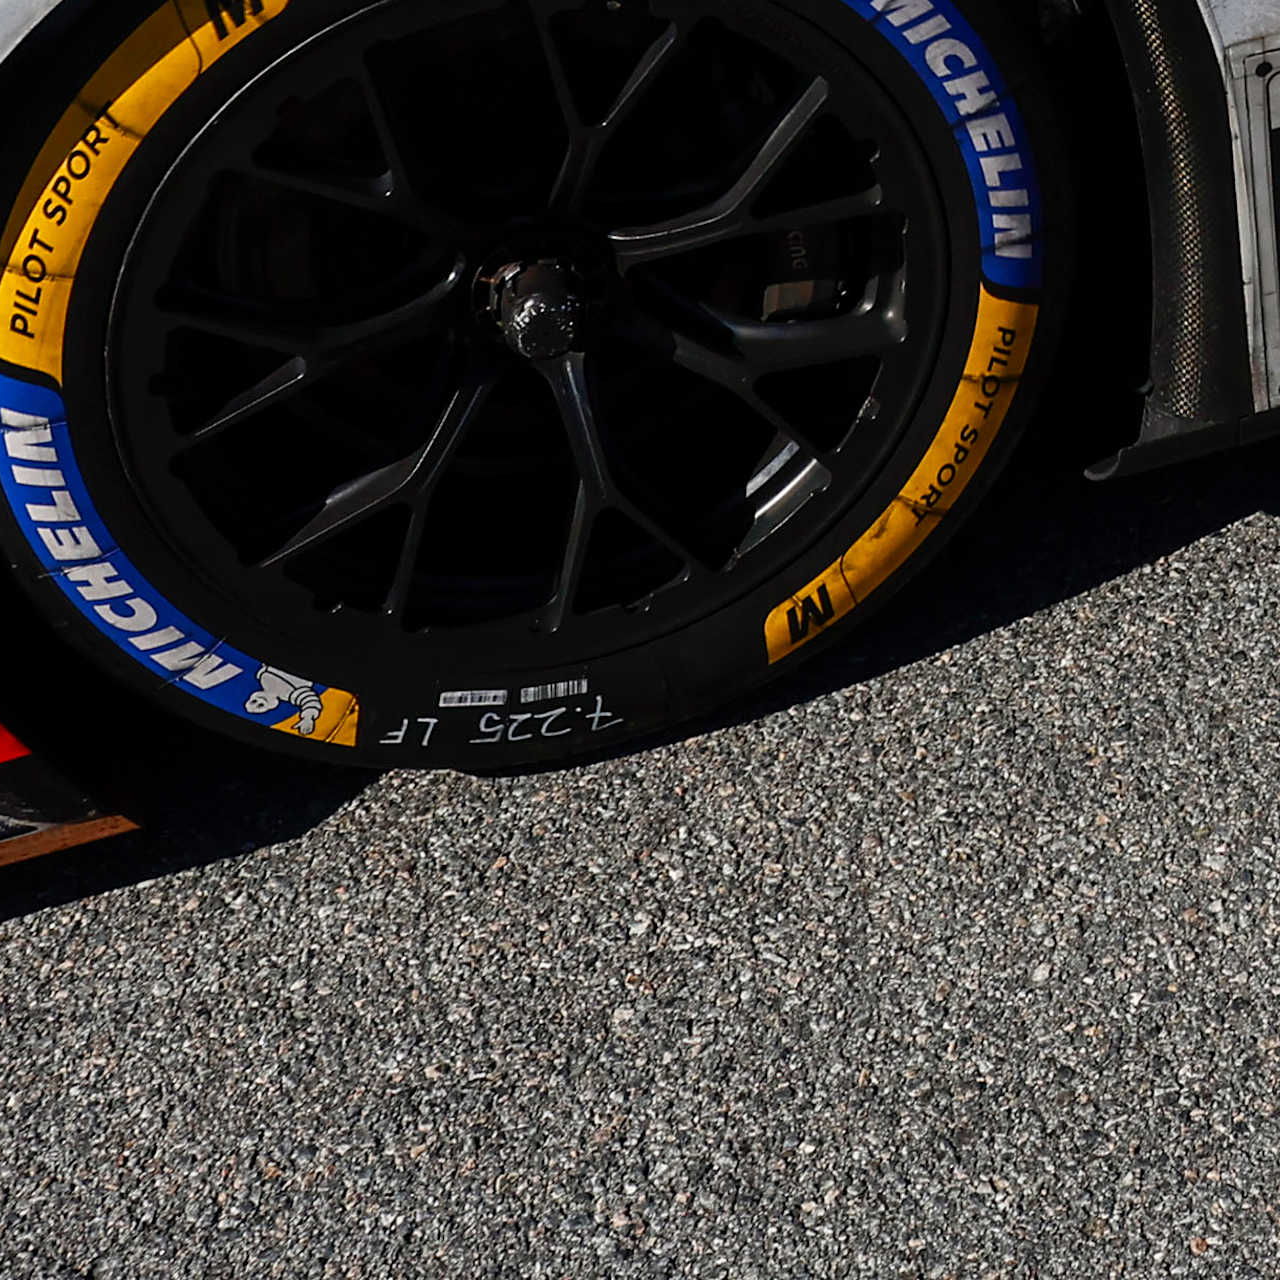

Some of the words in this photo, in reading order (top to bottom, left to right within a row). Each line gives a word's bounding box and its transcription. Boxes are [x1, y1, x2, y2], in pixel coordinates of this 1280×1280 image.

[9, 228, 55, 340] PILOT
[42, 99, 128, 227] SPORT
[974, 326, 1016, 419] PILOT
[911, 426, 980, 527] SPORT
[0, 406, 245, 692] MICHELIN
[787, 583, 833, 644] M
[378, 716, 439, 747] LF
